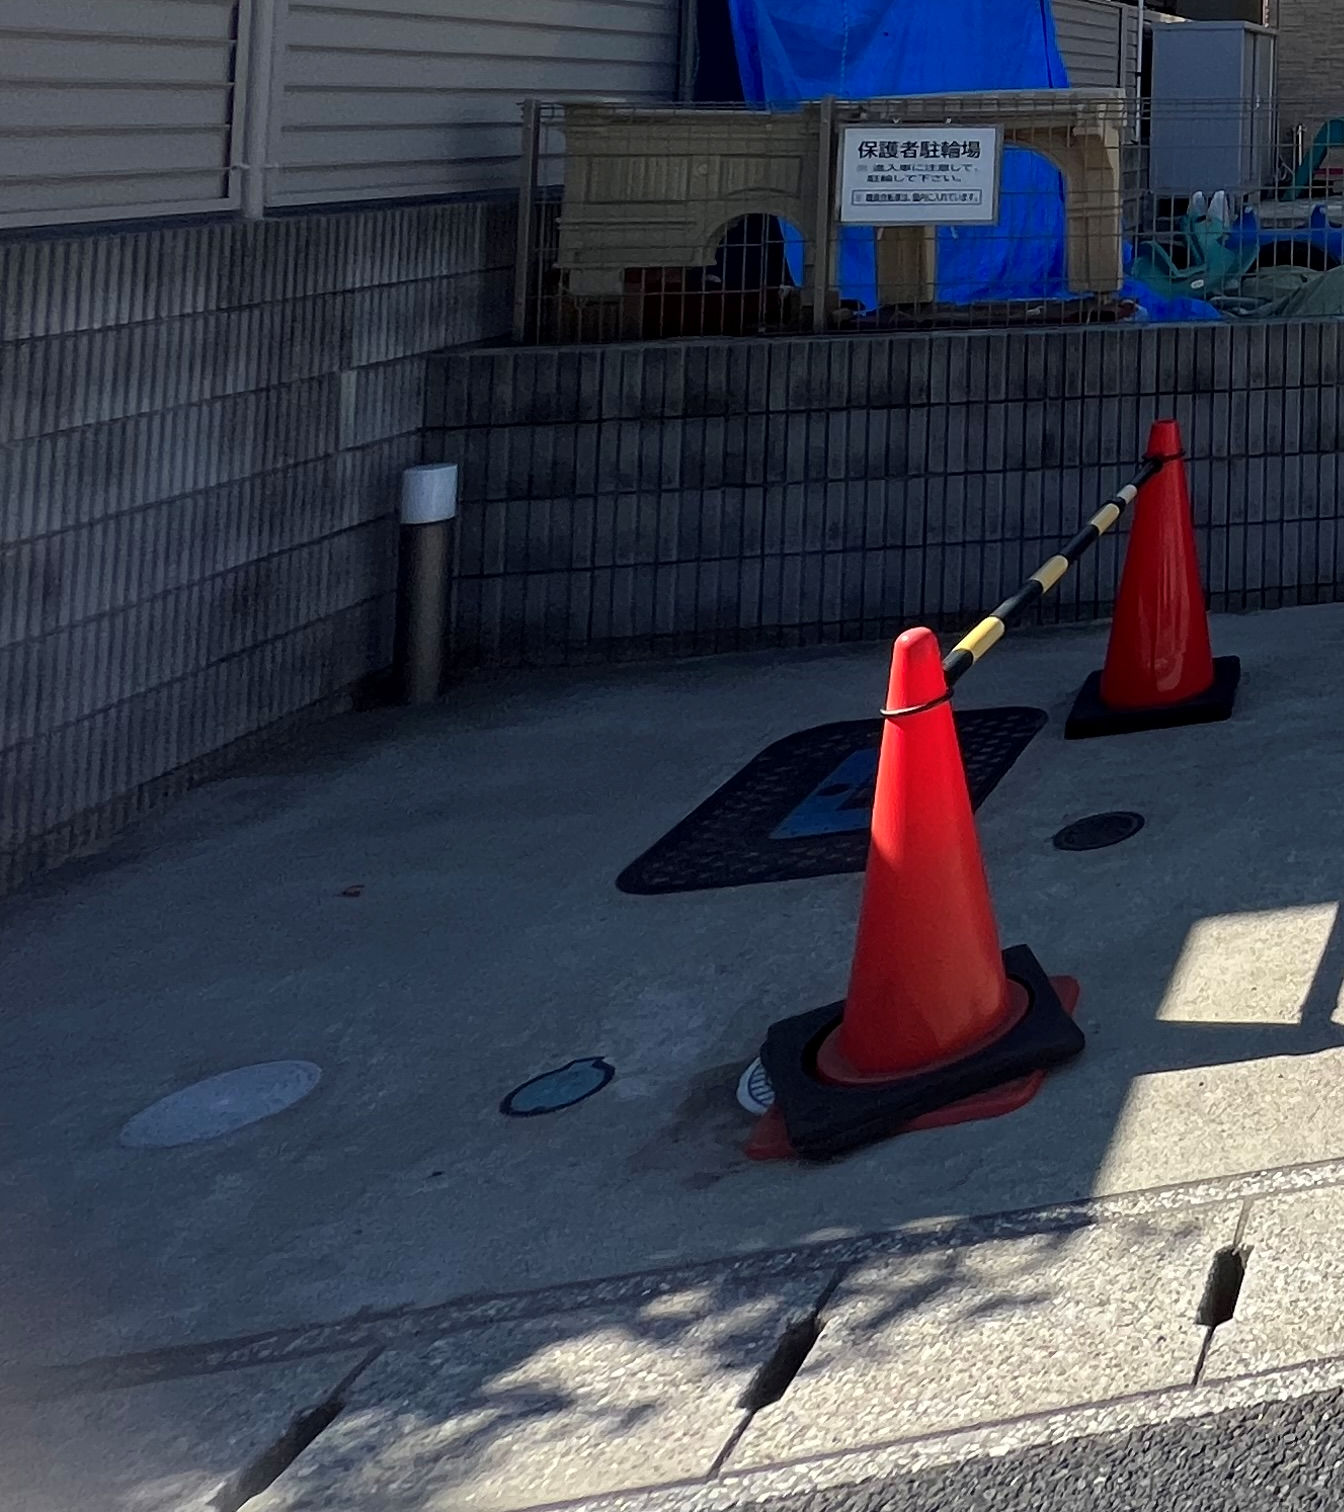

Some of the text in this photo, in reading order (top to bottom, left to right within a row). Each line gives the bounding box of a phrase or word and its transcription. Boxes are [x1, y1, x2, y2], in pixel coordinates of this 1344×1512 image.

[858, 140, 981, 159] 保護者駐輪場
